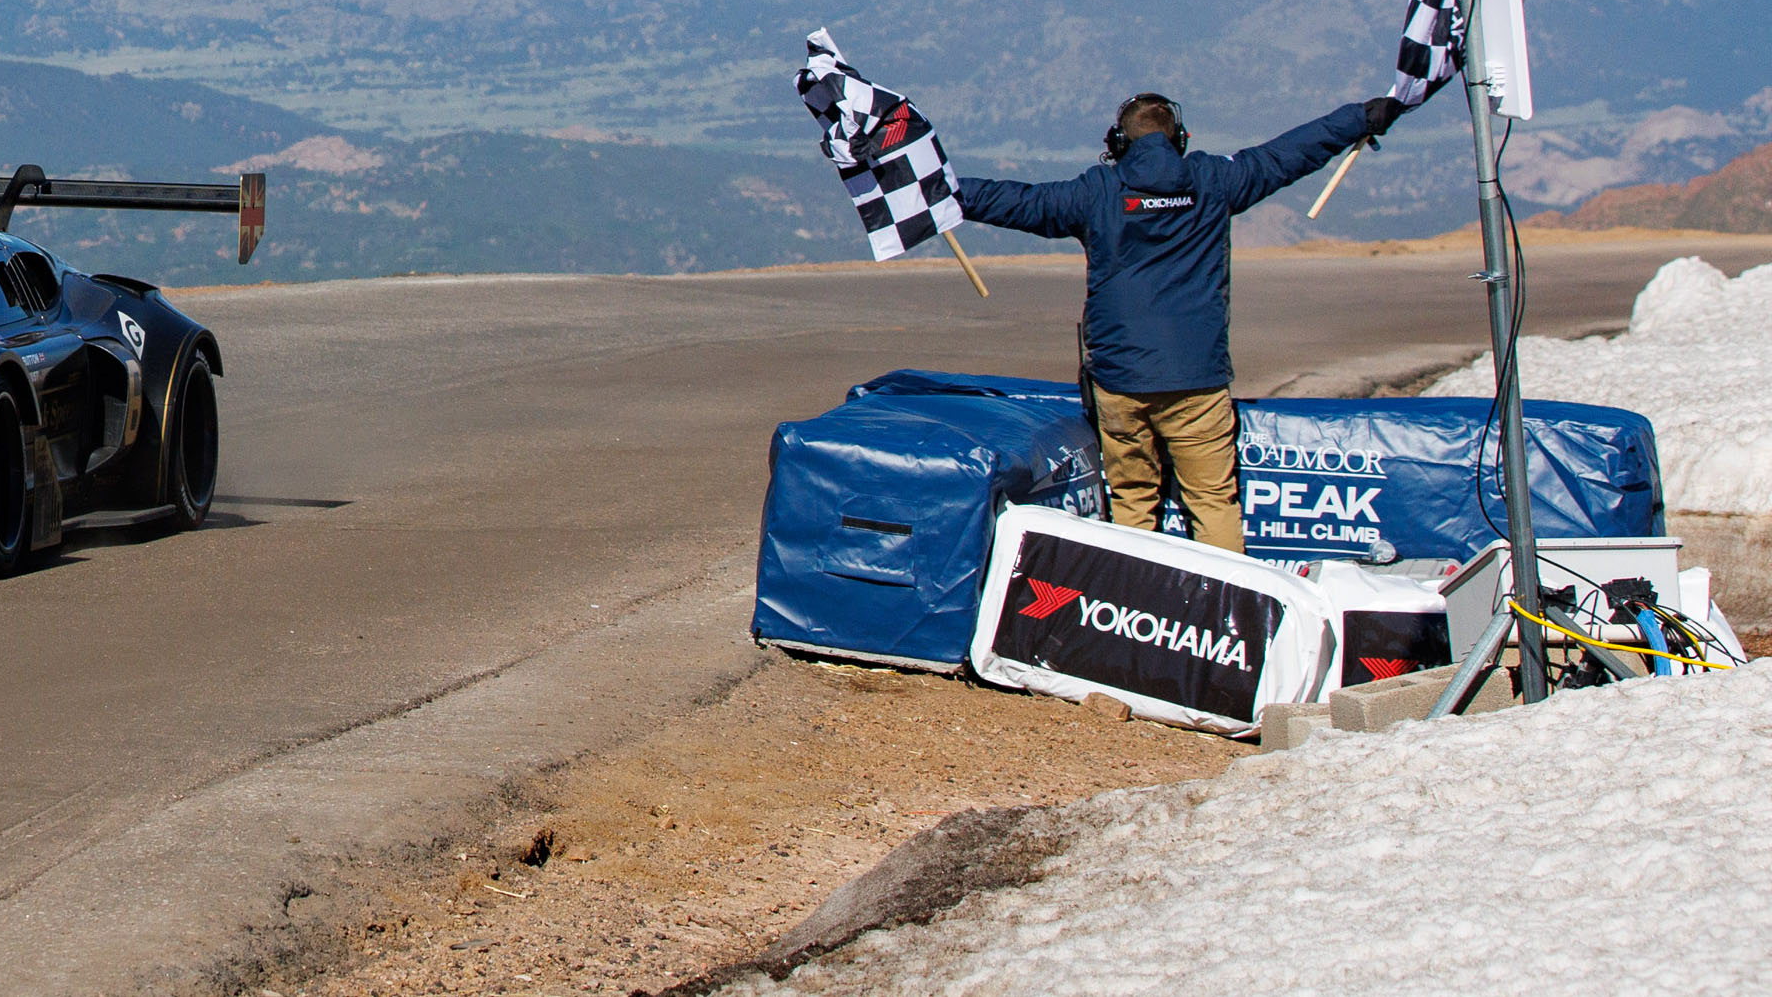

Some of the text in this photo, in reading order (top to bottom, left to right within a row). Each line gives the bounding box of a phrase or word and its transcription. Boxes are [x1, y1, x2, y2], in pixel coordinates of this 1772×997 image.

[1141, 196, 1194, 209] YOKOHAMA
[1243, 432, 1268, 444] THE
[1244, 479, 1383, 523] PEAK
[1260, 520, 1308, 539] HILL
[1310, 523, 1380, 544] CLIMB
[1079, 596, 1248, 671] YOKOHAMA
